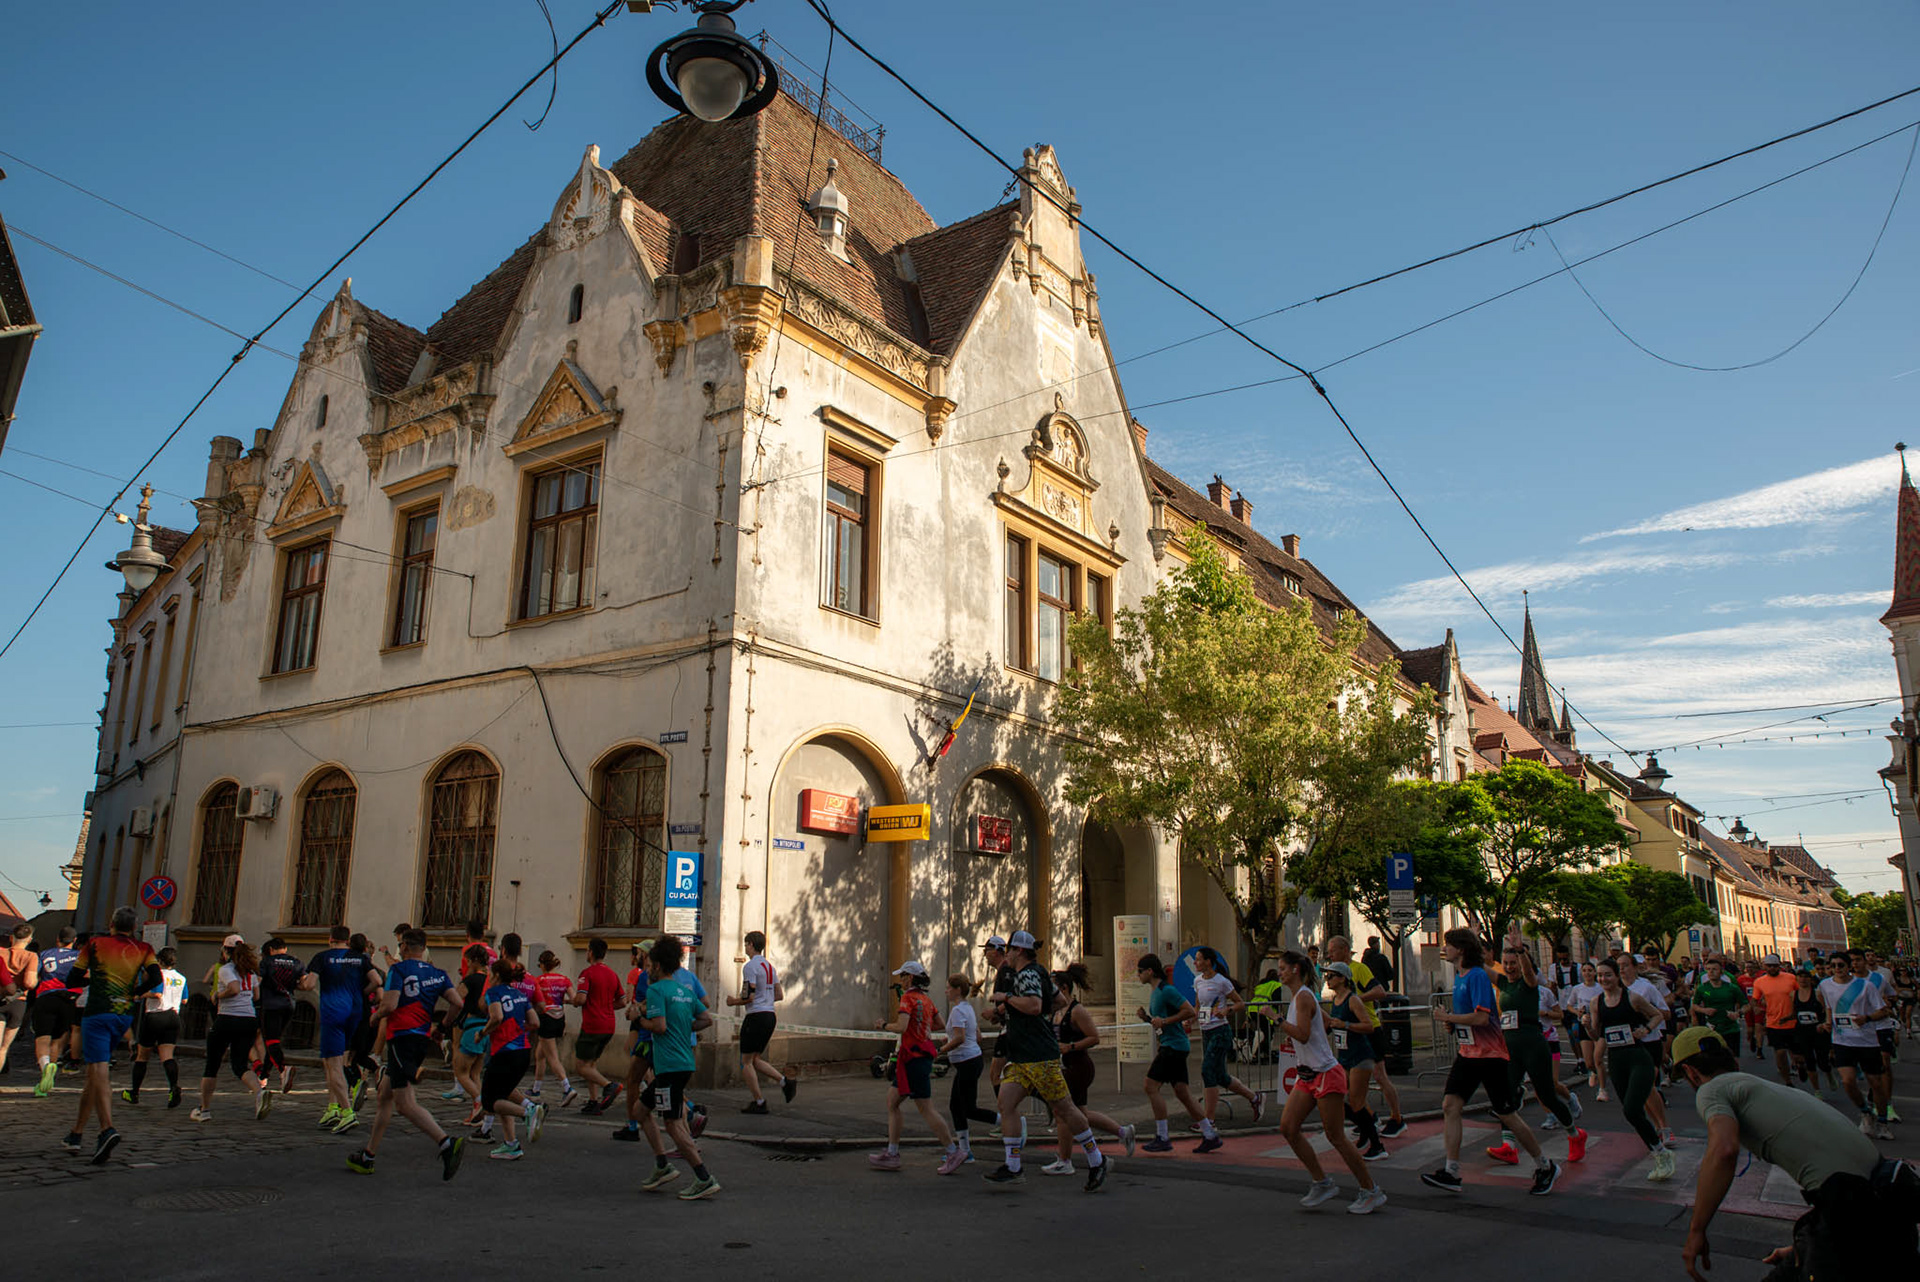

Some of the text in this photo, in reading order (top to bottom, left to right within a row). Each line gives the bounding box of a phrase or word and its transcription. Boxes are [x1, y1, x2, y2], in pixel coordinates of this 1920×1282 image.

[871, 816, 919, 827] WESTERN WU
[675, 857, 696, 889] P
[1394, 858, 1409, 880] P
[1691, 930, 1698, 939] P
